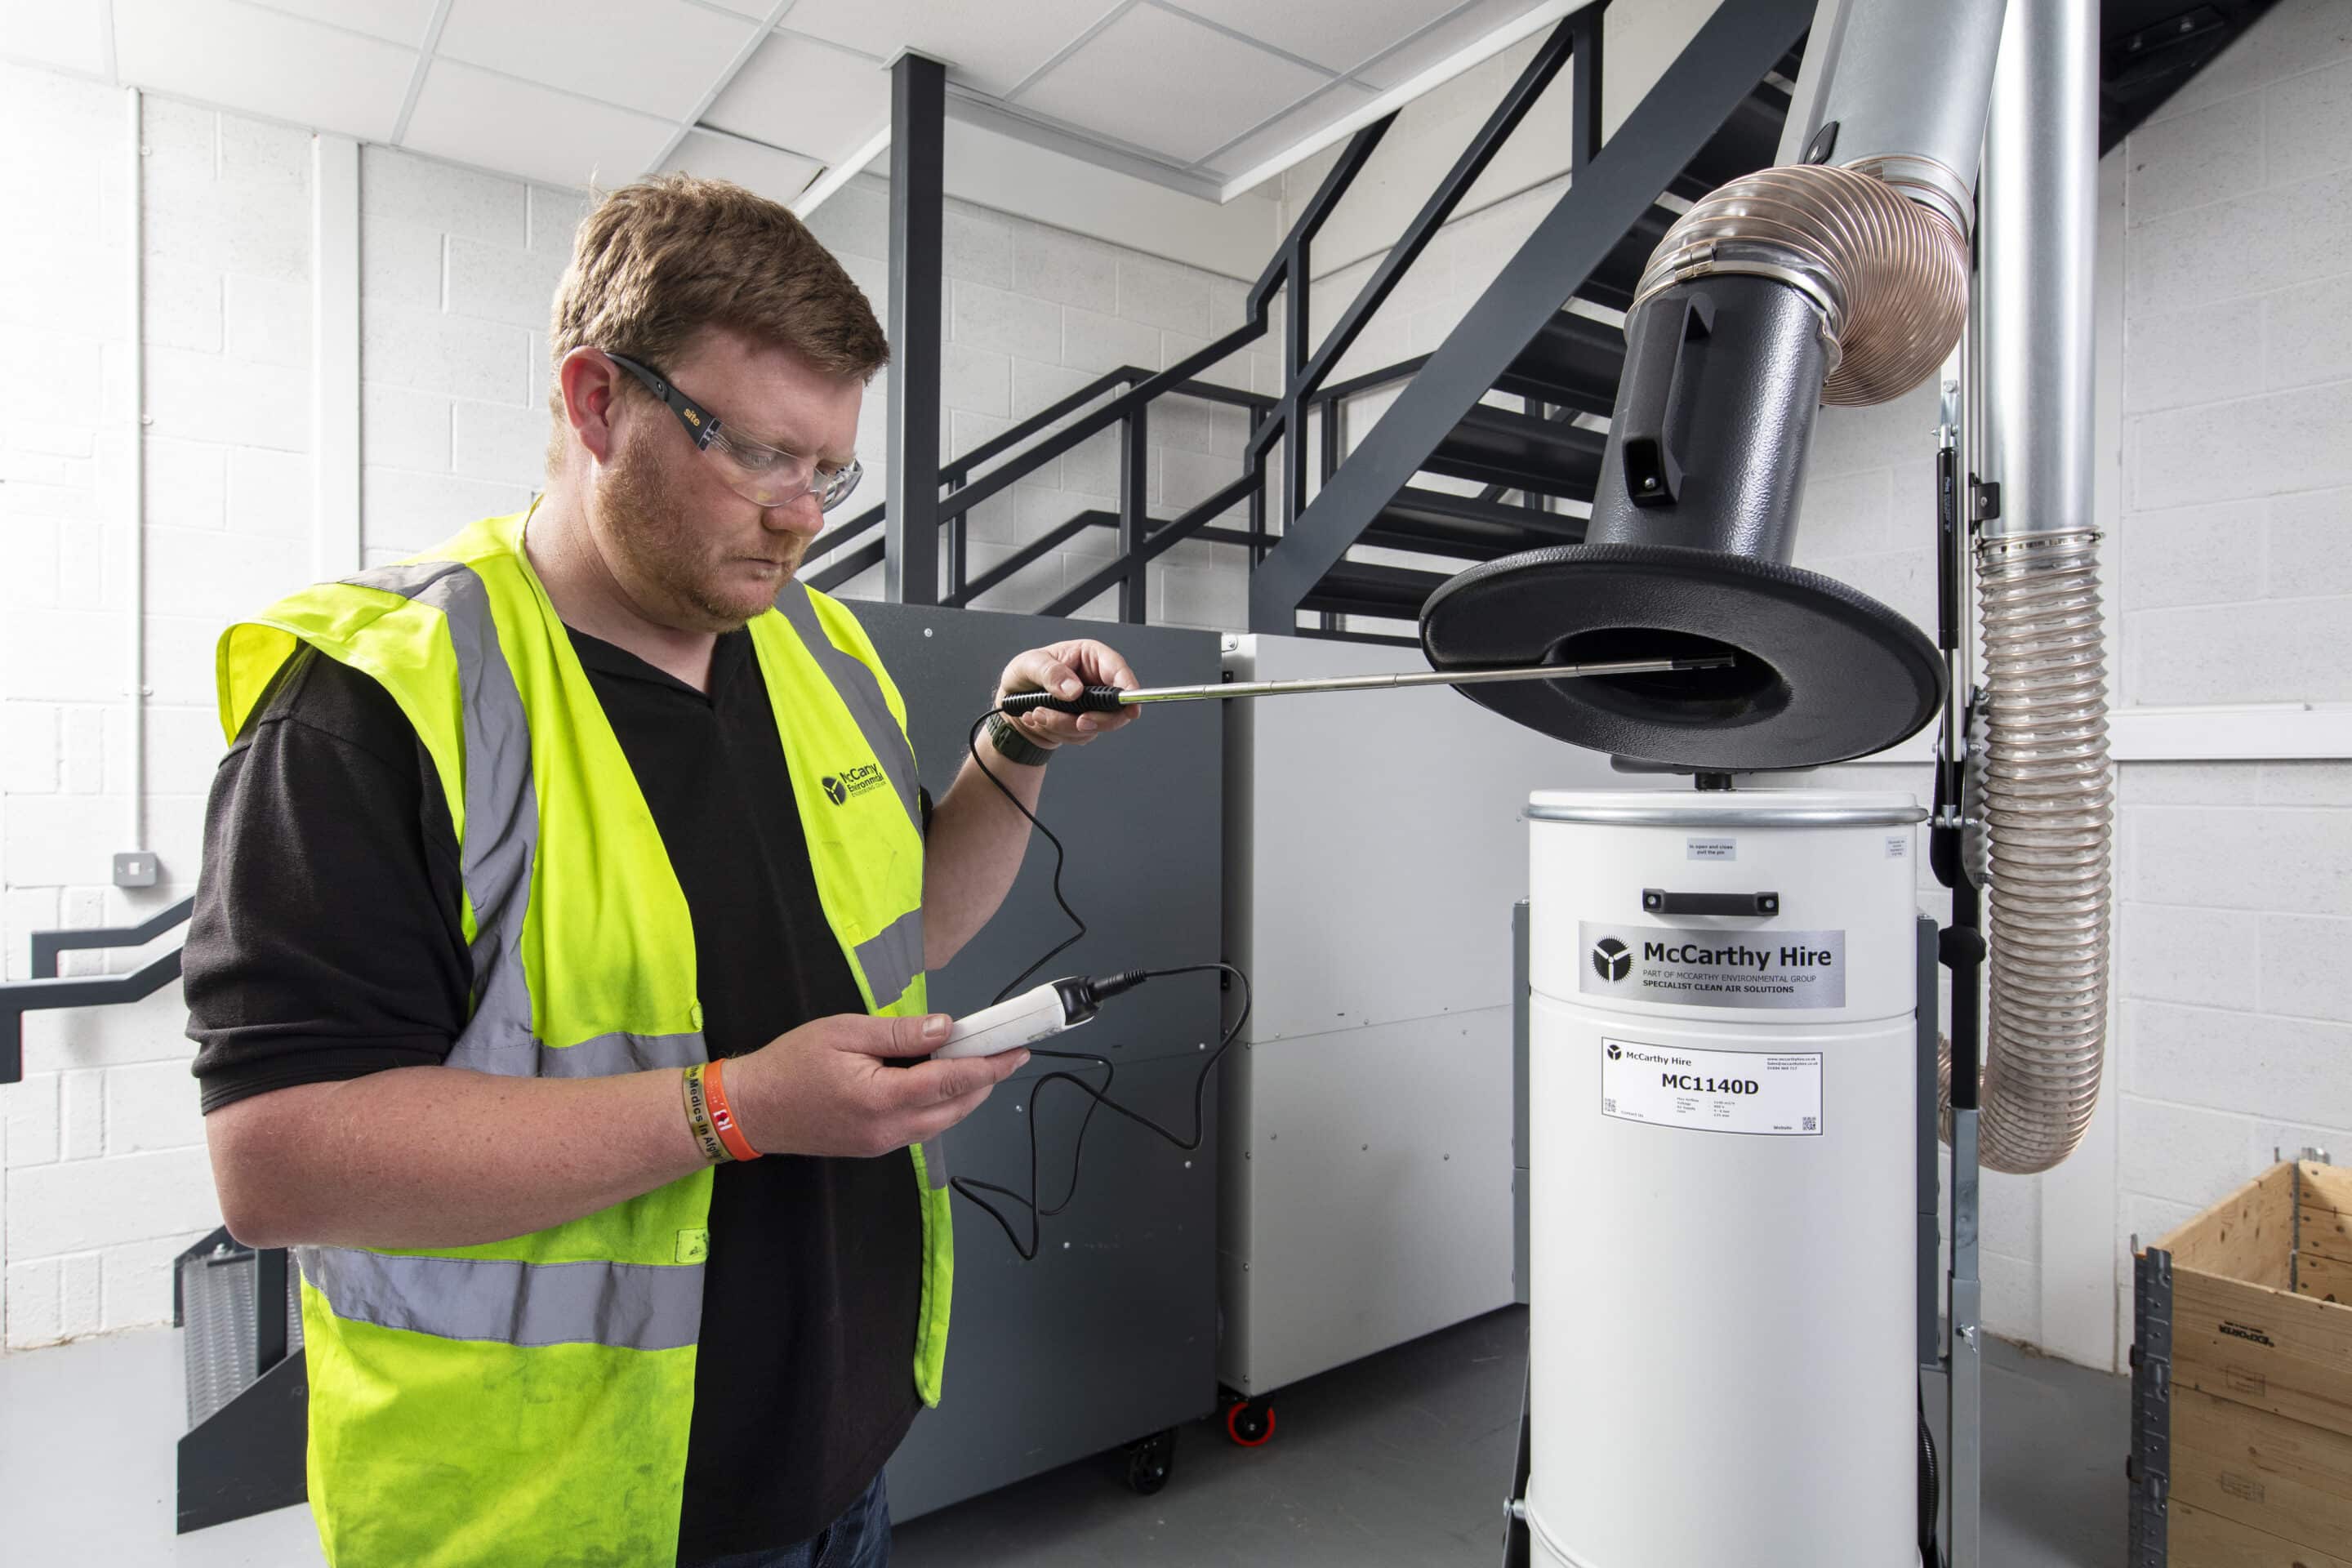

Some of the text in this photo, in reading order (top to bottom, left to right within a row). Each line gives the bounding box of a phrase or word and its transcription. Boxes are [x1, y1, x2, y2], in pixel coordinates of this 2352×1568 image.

[684, 408, 701, 427] site
[1644, 942, 1831, 972] McCarthy Hire
[1643, 969, 1817, 983] PART OF MCCARTHY ENVIRONMENTAL GROUP
[1642, 980, 1692, 991] SPECIALIST
[1695, 983, 1722, 991] CLEAN
[1744, 985, 1794, 994] SOLUTIONS
[1626, 1051, 1692, 1067] McCarthy Hire
[1661, 1072, 1760, 1095] MC1140D
[689, 1078, 704, 1123] Medics
